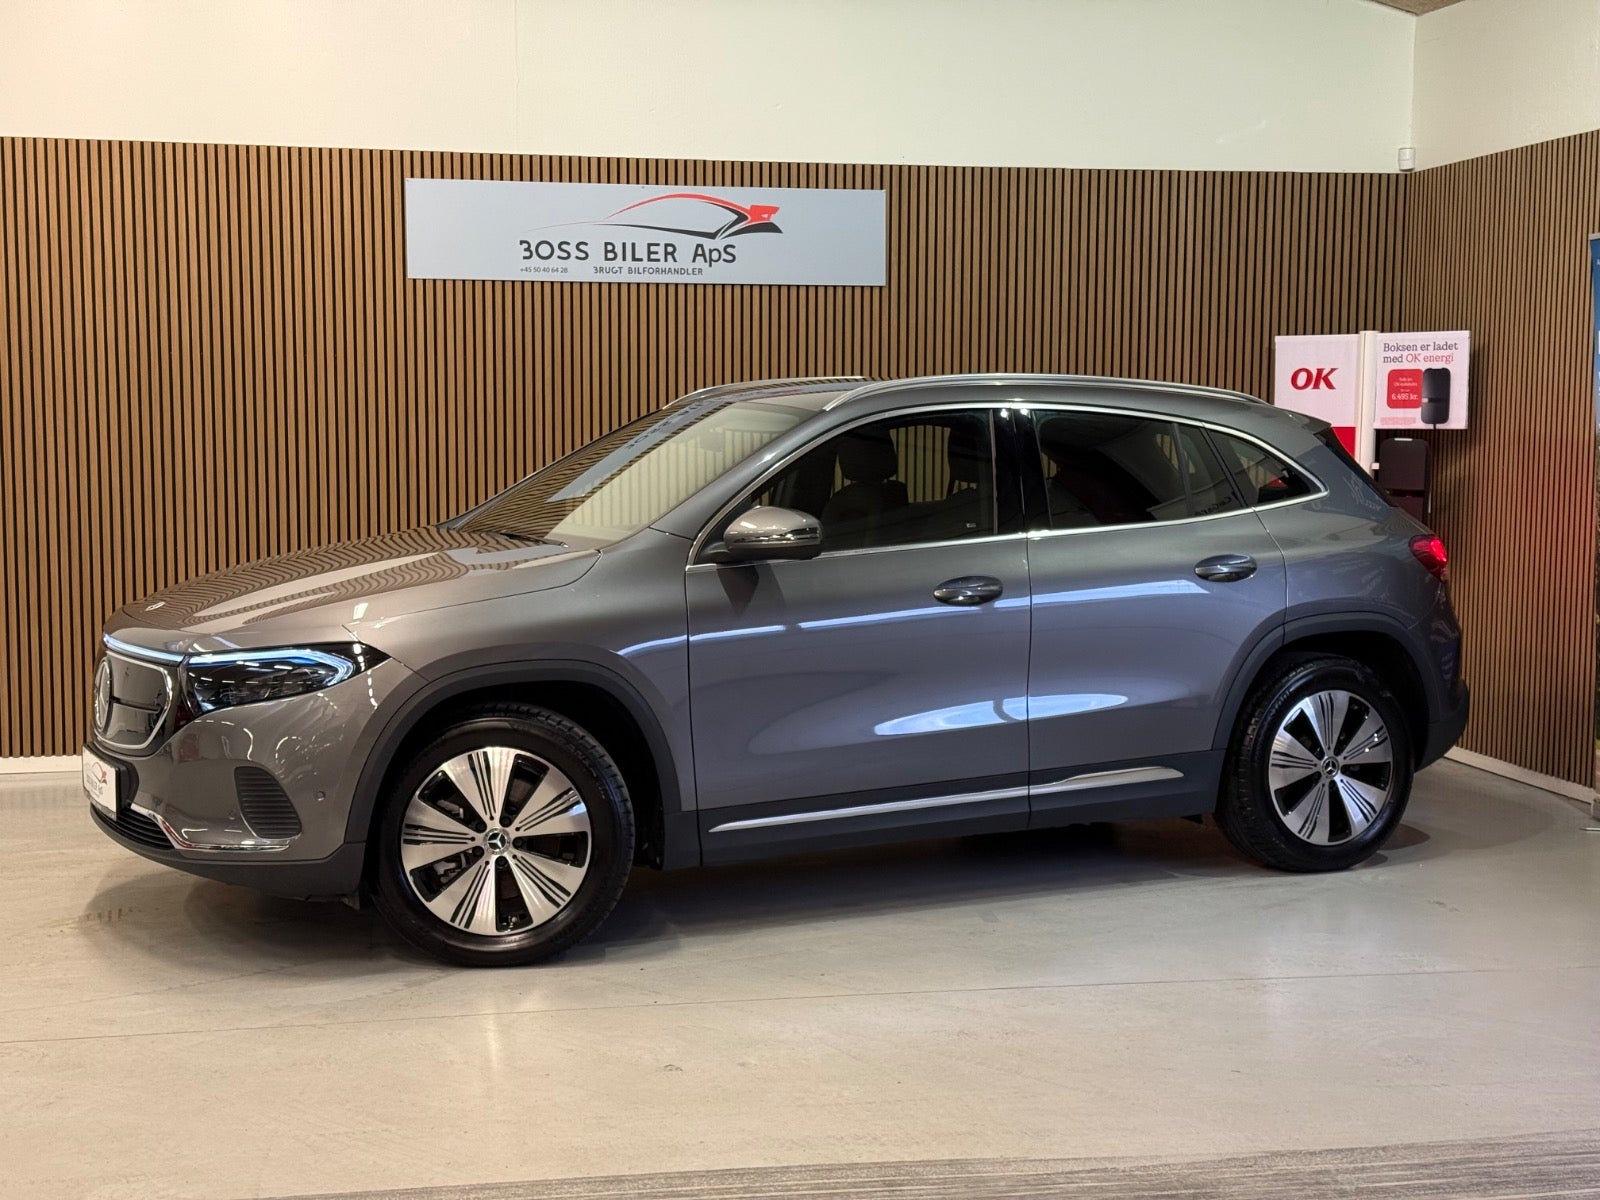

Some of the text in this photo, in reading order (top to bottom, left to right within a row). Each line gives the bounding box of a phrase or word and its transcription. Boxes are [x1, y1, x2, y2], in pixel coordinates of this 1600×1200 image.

[519, 240, 737, 267] BOSS BILER ApS
[560, 266, 569, 274] 28
[593, 266, 703, 276] BRUGT BILFORHANDLER
[1383, 341, 1459, 352] Boksen er ladet
[1383, 353, 1454, 365] med OK energi
[1290, 367, 1339, 390] OK
